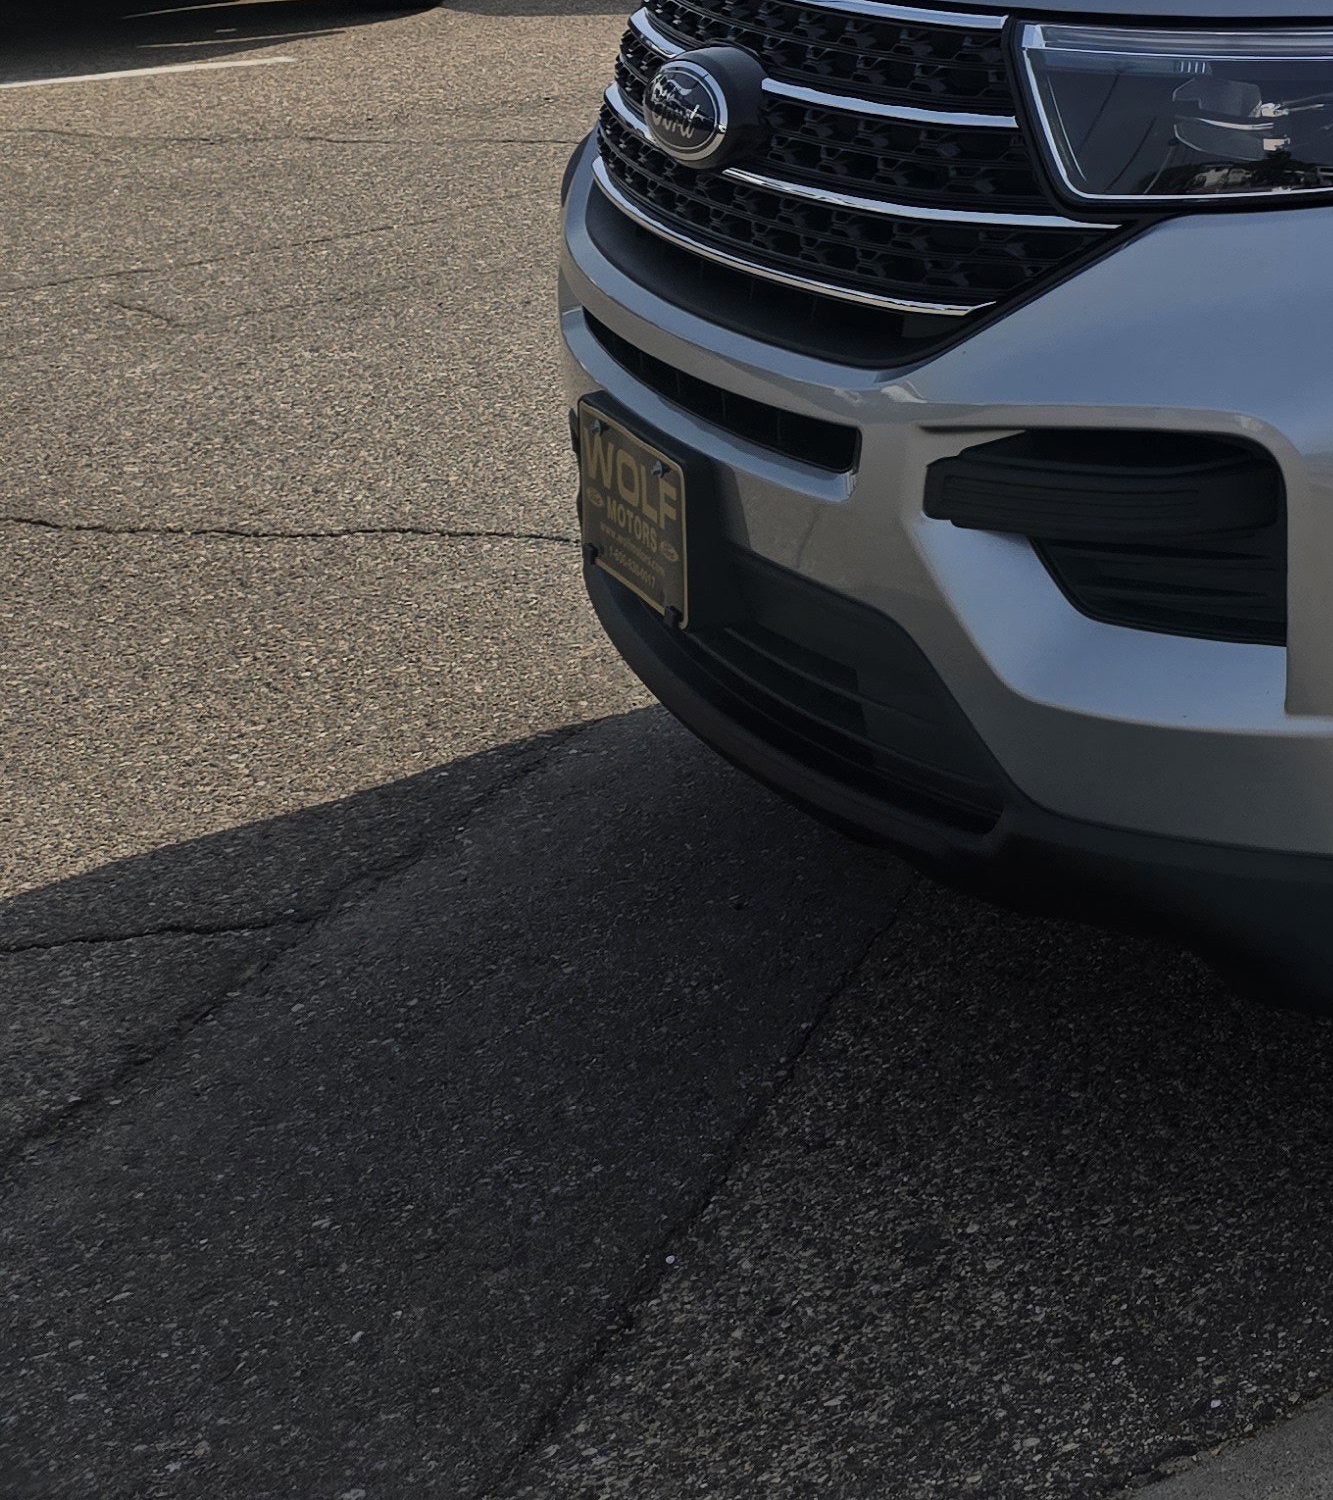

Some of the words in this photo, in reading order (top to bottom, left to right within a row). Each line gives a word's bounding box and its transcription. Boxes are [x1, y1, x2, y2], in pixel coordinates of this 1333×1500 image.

[651, 78, 701, 139] Ford
[583, 426, 677, 530] WOLF
[606, 498, 657, 554] MOTORS
